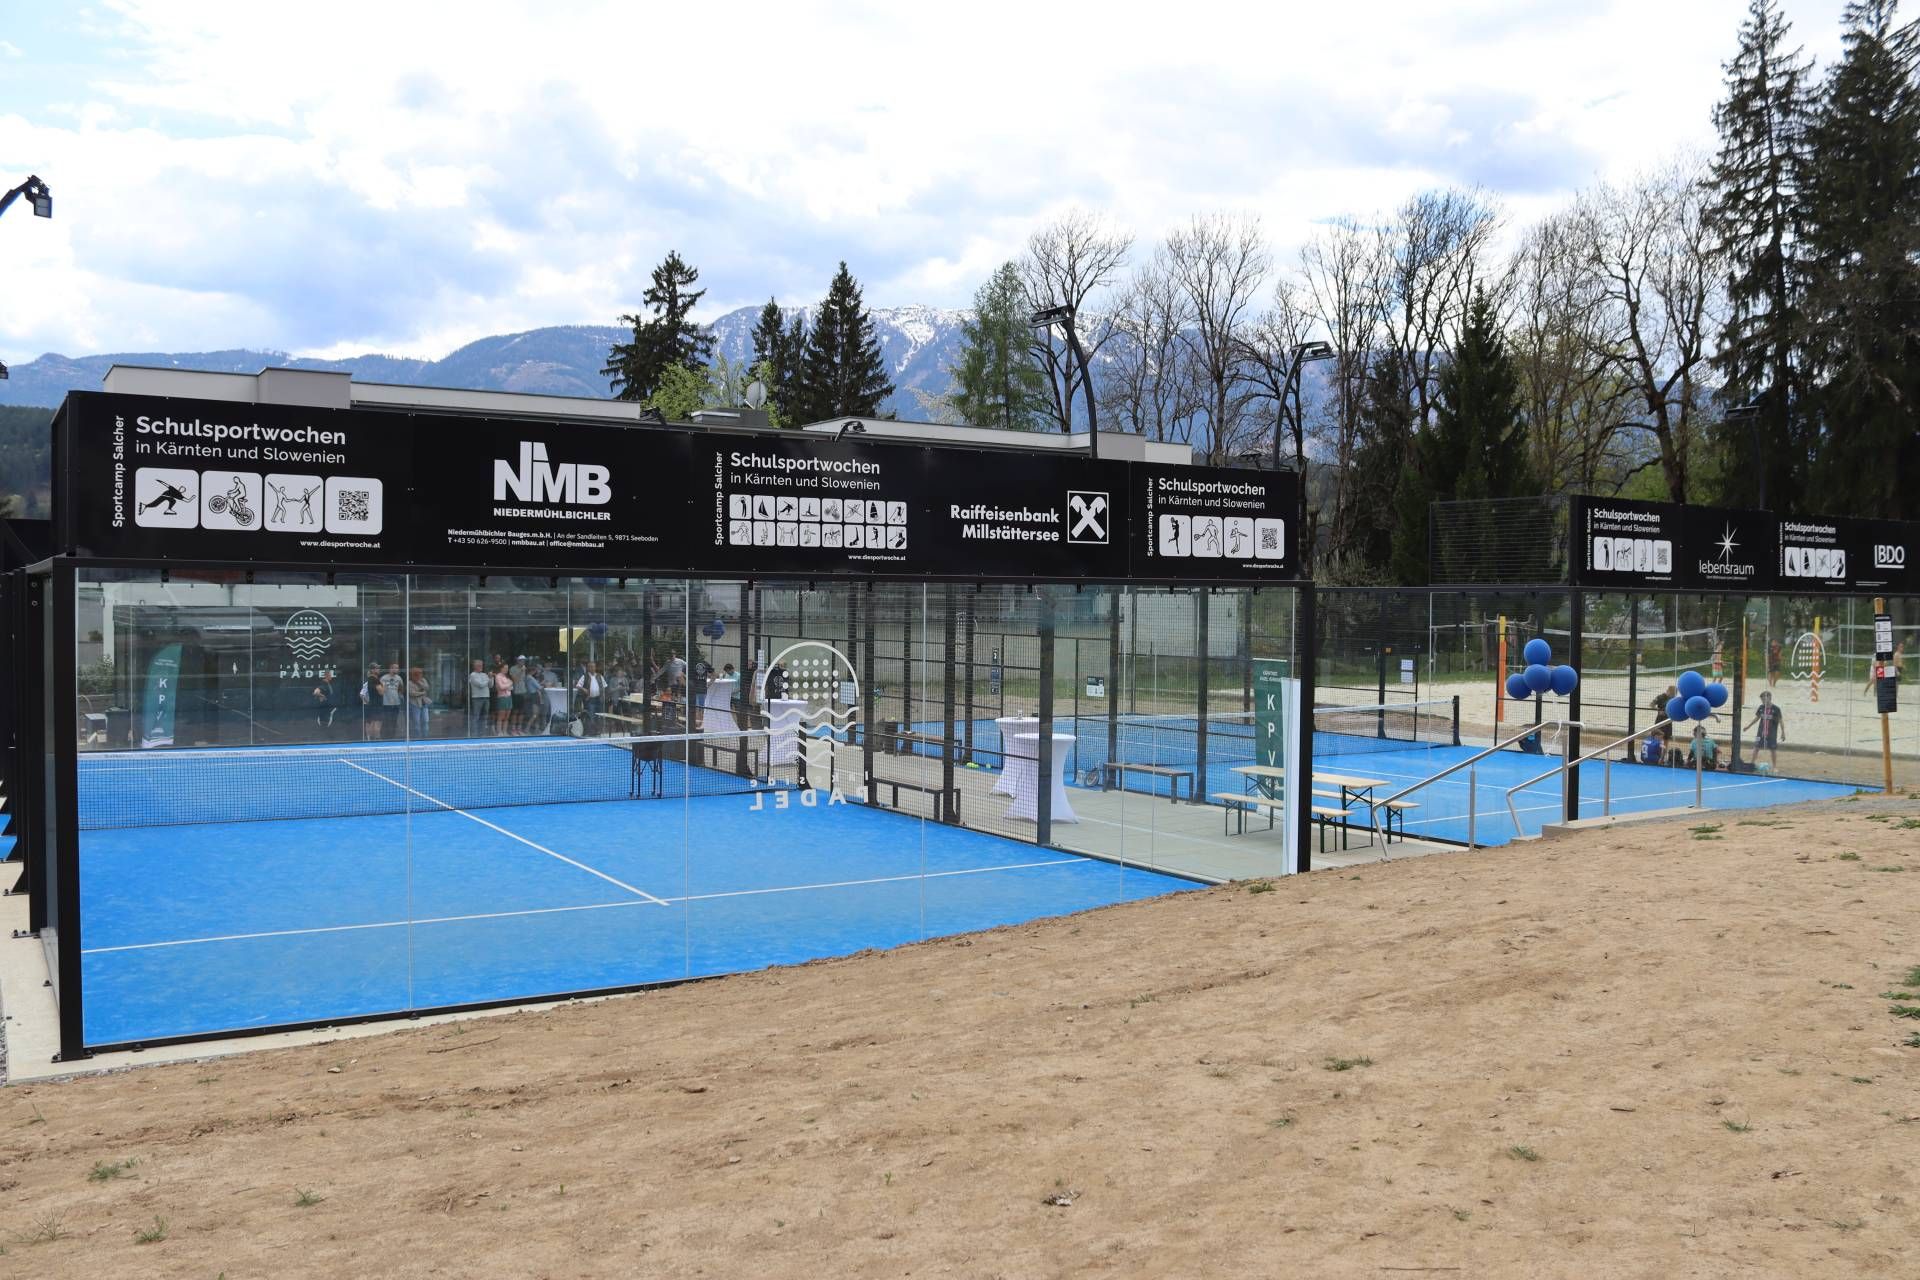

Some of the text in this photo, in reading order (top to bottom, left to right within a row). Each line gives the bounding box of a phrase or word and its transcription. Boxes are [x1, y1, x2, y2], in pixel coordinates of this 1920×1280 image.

[135, 415, 346, 446] Schulsportwochen
[135, 441, 346, 464] in Kärnten und Slowenien
[112, 415, 125, 528] Sportcamp Salcher
[730, 452, 880, 475] Schulsportwochen
[494, 441, 612, 505] NMB
[730, 472, 880, 491] in Kärnten und Slowenien
[1158, 477, 1266, 496] Schulsportwochen
[715, 451, 724, 545] Sportcamp Salcher
[1158, 495, 1266, 509] in Kärnten und Slowenien
[493, 507, 611, 521] NIEDERMÜHLBICHLER
[950, 504, 1060, 523] Raiffeisenbank
[1593, 507, 1660, 523] Schulsportwochen
[448, 529, 506, 538] Niedermühlbichler
[507, 531, 552, 539] Bauges.m.b.H.
[962, 524, 1060, 542] Millstättersee
[1622, 524, 1632, 532] und
[1784, 522, 1836, 534] Schulsportwochen
[300, 540, 381, 549] www.diesportwoche.at
[512, 539, 545, 547] nmbbau.at
[549, 540, 604, 548] office@nmbbau.at
[1878, 544, 1905, 564] BDO
[1698, 560, 1755, 575] lebensraum
[280, 670, 337, 679] PADEL
